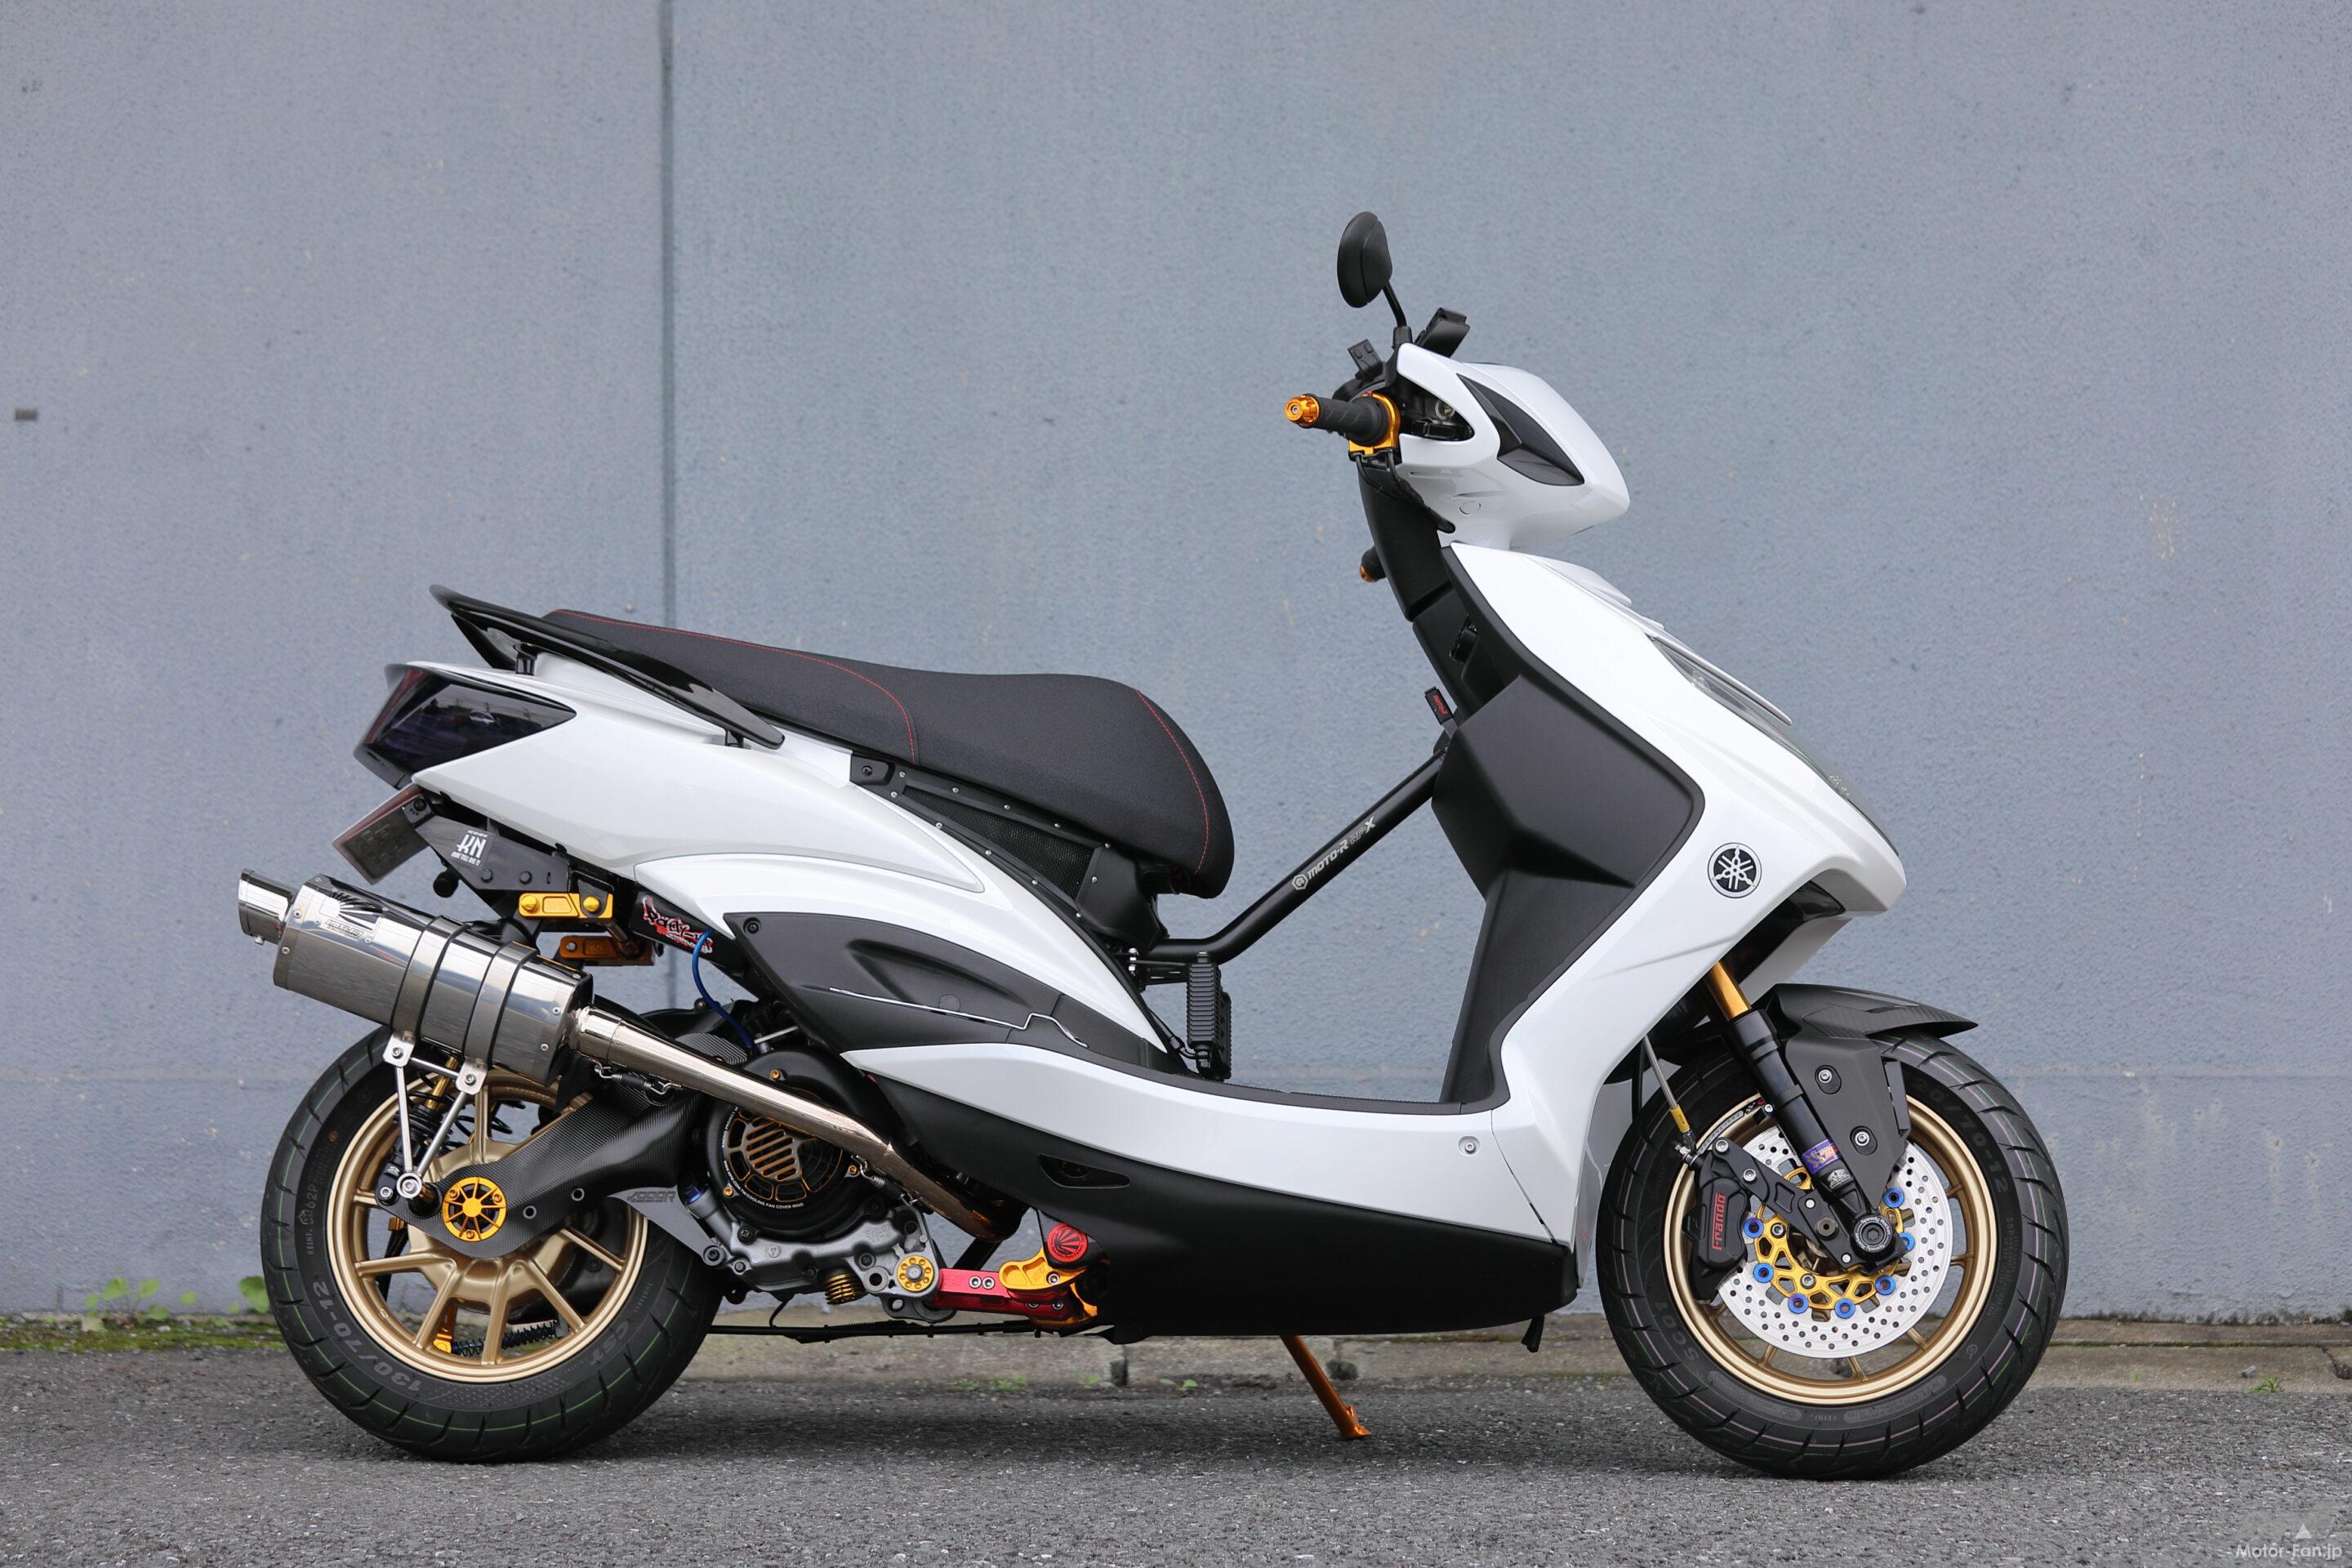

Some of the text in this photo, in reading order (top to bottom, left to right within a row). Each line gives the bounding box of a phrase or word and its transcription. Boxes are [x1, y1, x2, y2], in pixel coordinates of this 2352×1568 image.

[457, 834, 487, 858] KN
[1307, 839, 1349, 880] MOTO-R
[1912, 1076, 2013, 1193] 20/70-12
[1712, 1192, 1726, 1251] Frando
[313, 1281, 422, 1392] 130/70-12
